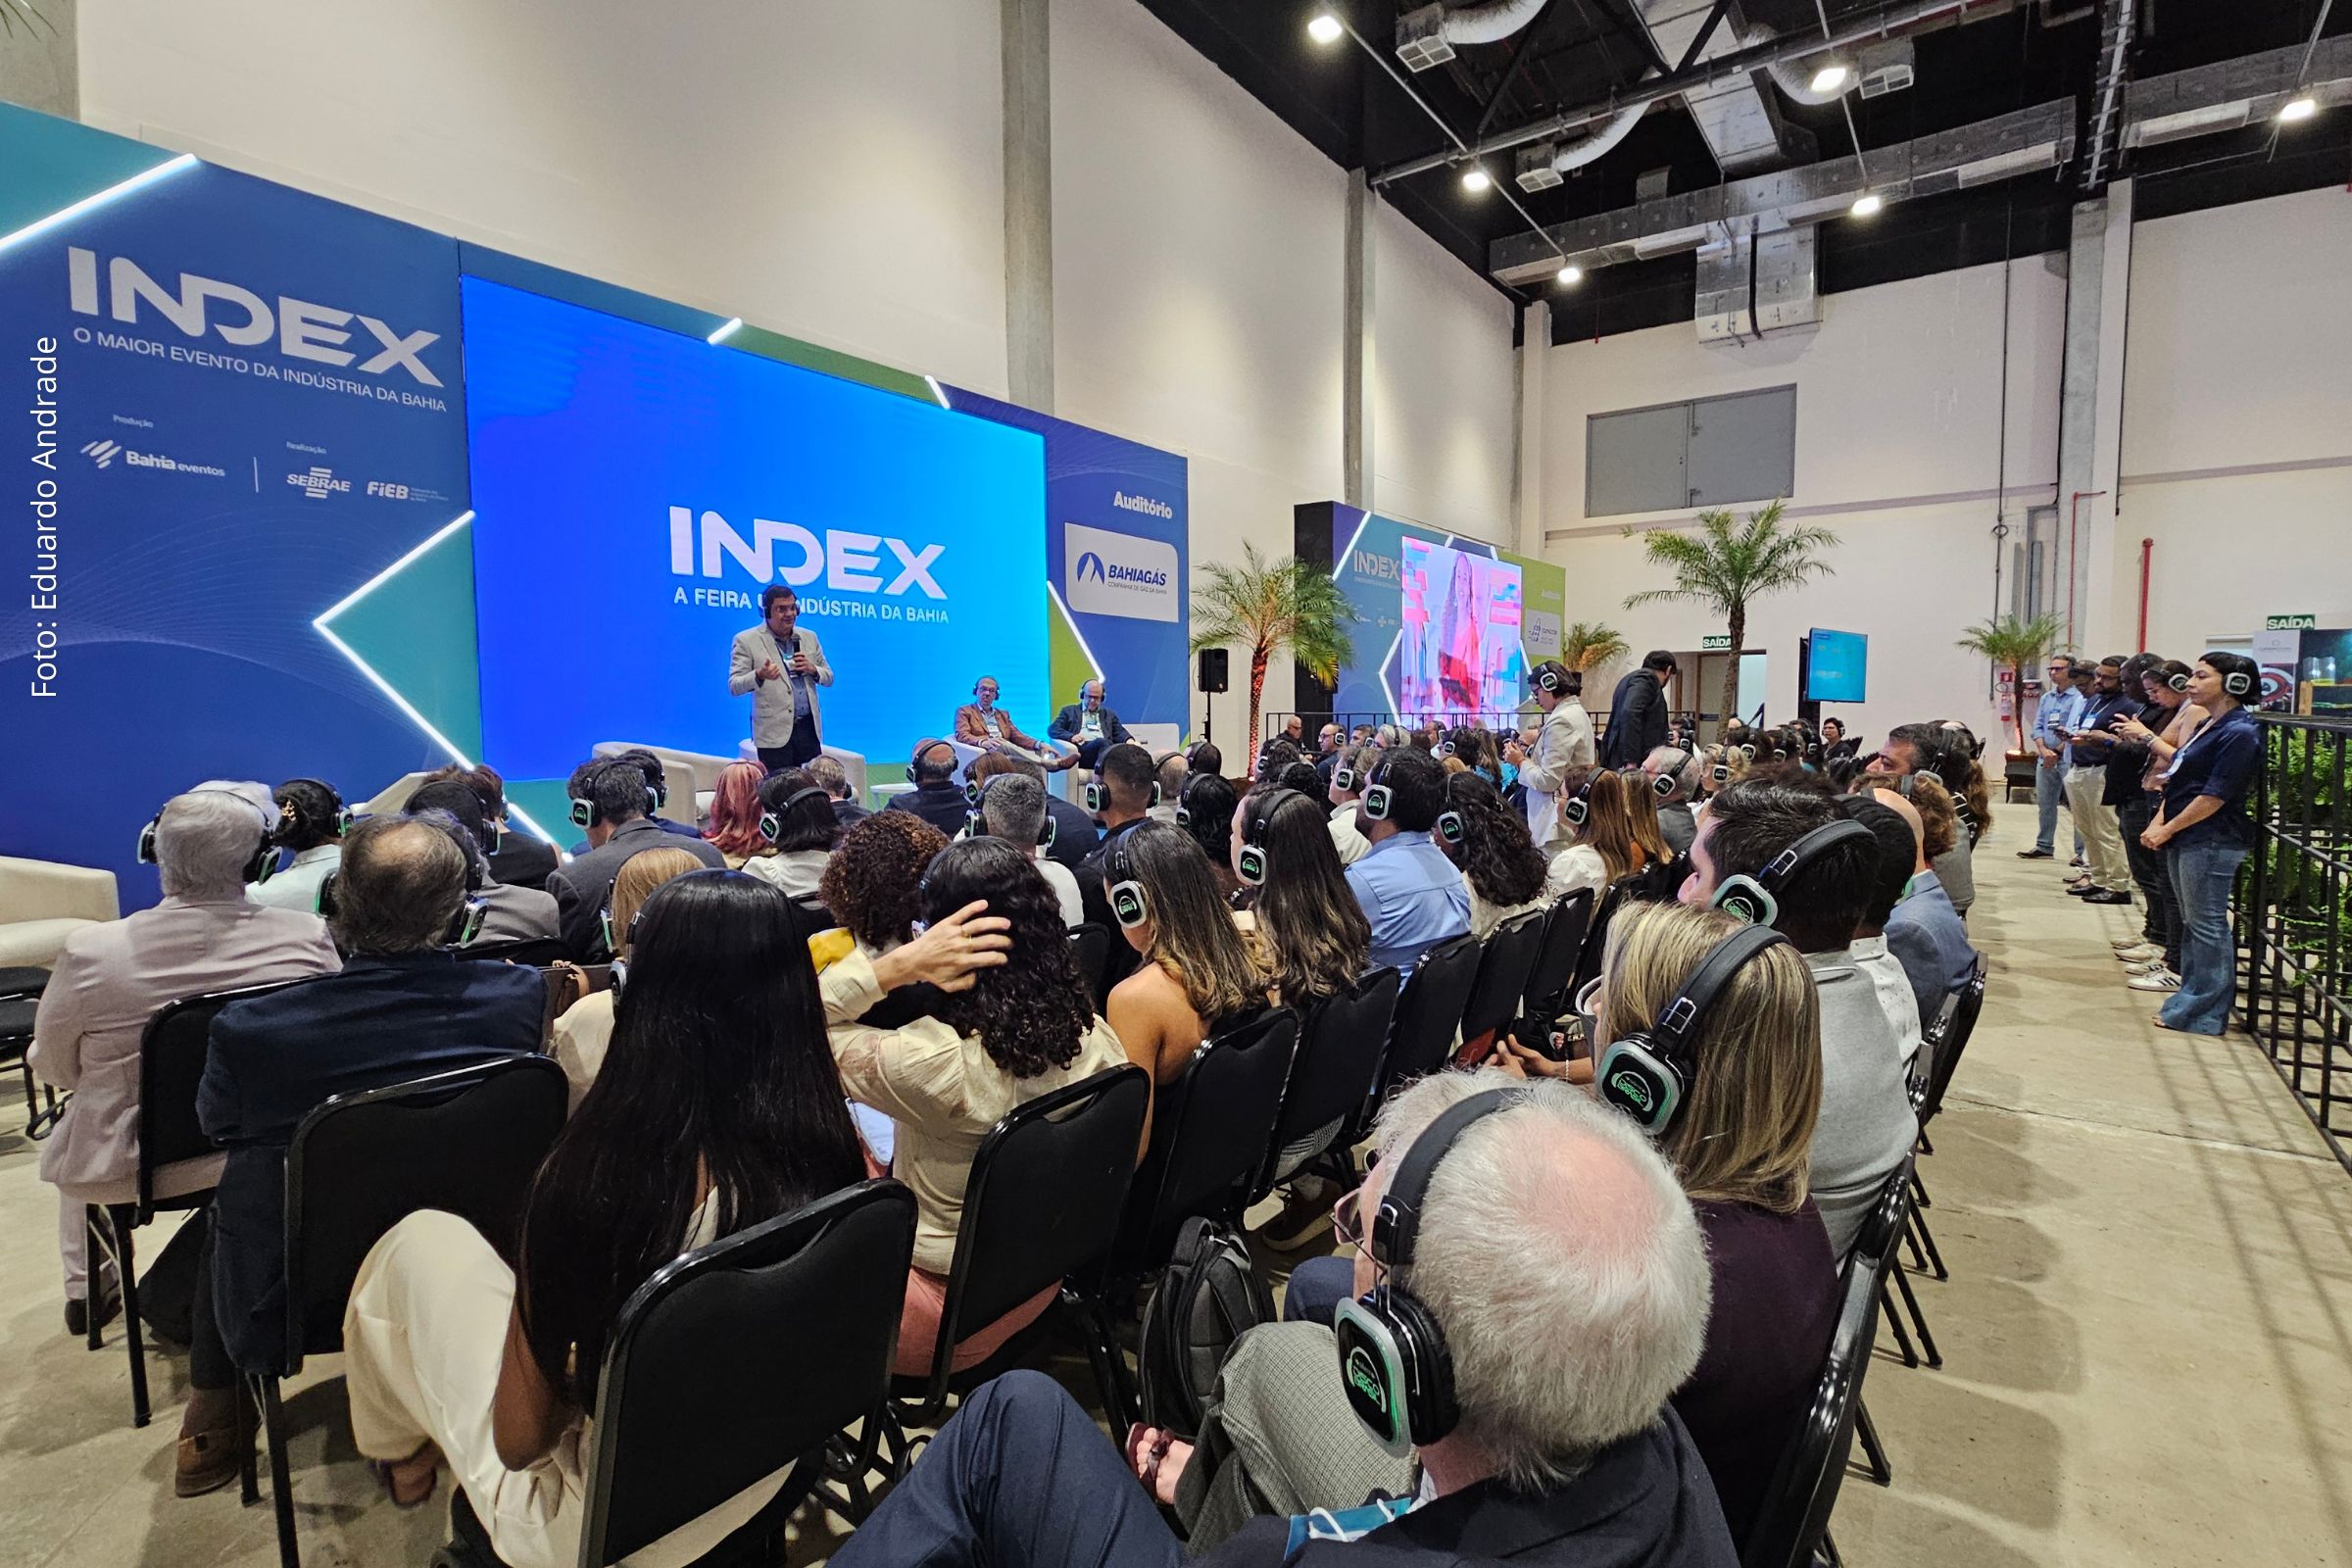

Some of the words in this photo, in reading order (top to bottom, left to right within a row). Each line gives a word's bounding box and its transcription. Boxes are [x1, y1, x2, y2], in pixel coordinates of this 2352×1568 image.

[68, 246, 445, 387] INDEX
[74, 326, 91, 343] O
[98, 331, 165, 358] MAIOR
[171, 346, 248, 373] EVENTO
[253, 362, 279, 380] DA
[283, 368, 372, 398] INDÚSTRIA
[376, 387, 399, 403] DA
[402, 391, 447, 413] BAHIA
[125, 450, 176, 470] Bahia
[177, 462, 225, 477] eventos
[286, 473, 351, 492] SEBRAE
[1113, 491, 1172, 518] Auditório
[668, 505, 949, 601] INDEX
[1353, 549, 1400, 581] INDEX
[1108, 564, 1166, 586] BAHIAGÁS
[673, 586, 688, 605] A
[694, 588, 753, 610] FEIRA
[795, 595, 878, 619] NDÚSTRIA
[881, 604, 903, 620] DA
[906, 606, 950, 624] BAHIA
[2268, 615, 2314, 629] SAÍDA
